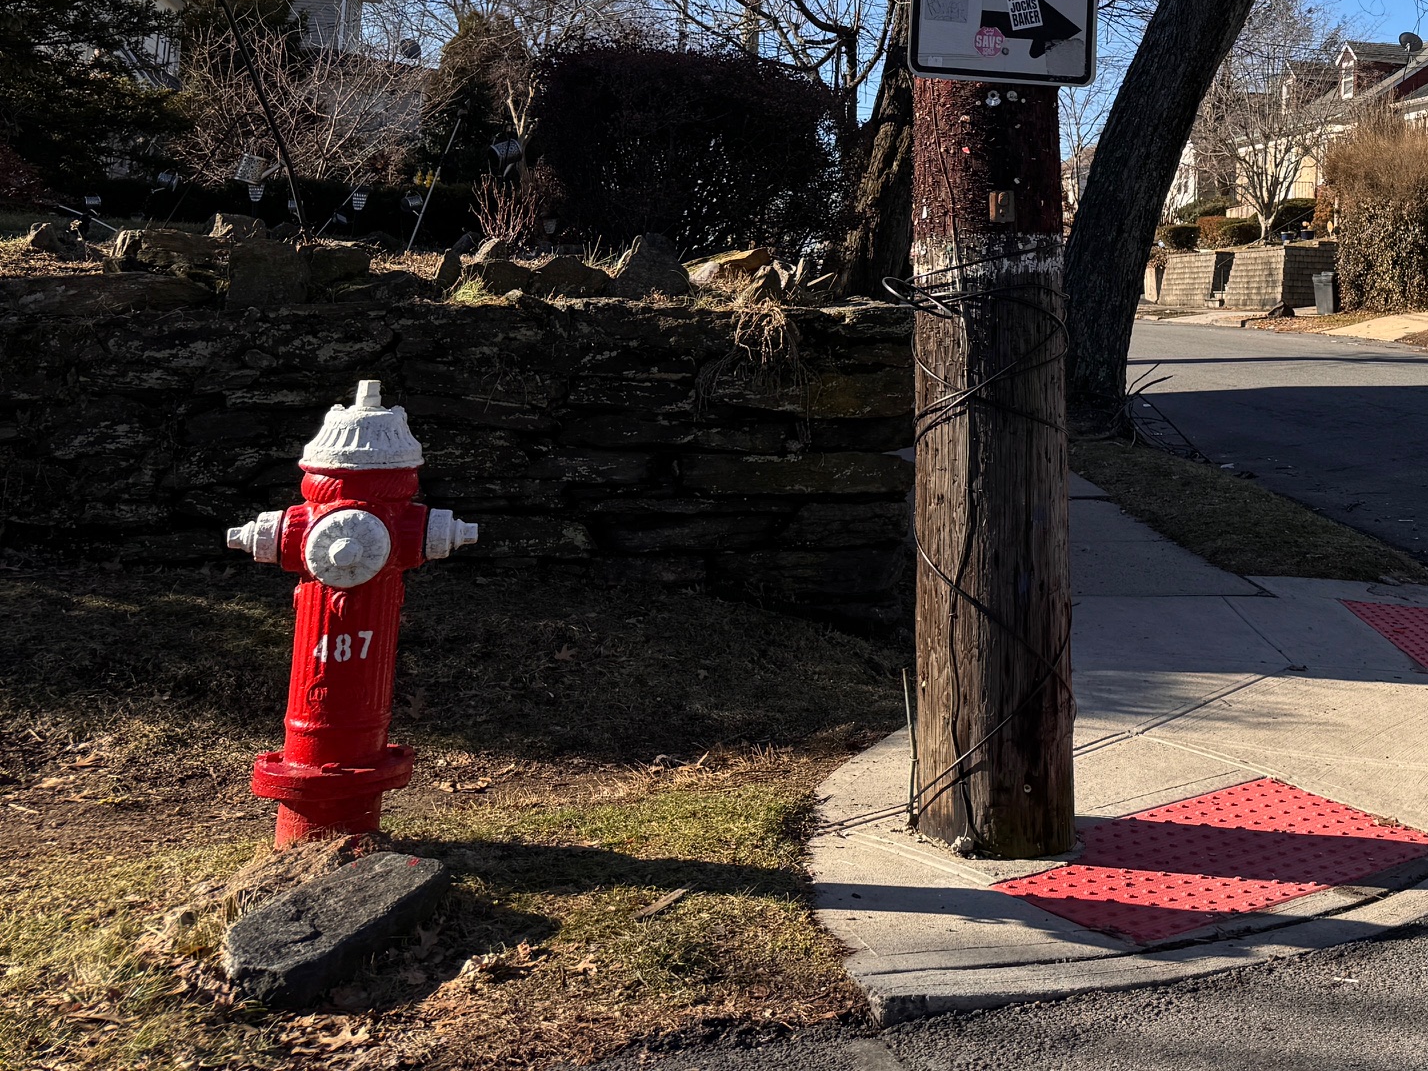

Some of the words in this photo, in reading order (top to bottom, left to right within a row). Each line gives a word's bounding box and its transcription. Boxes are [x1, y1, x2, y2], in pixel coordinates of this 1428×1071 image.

[1010, 0, 1038, 13] JOCKS
[1011, 10, 1041, 27] BAKER
[313, 630, 374, 663] 487
